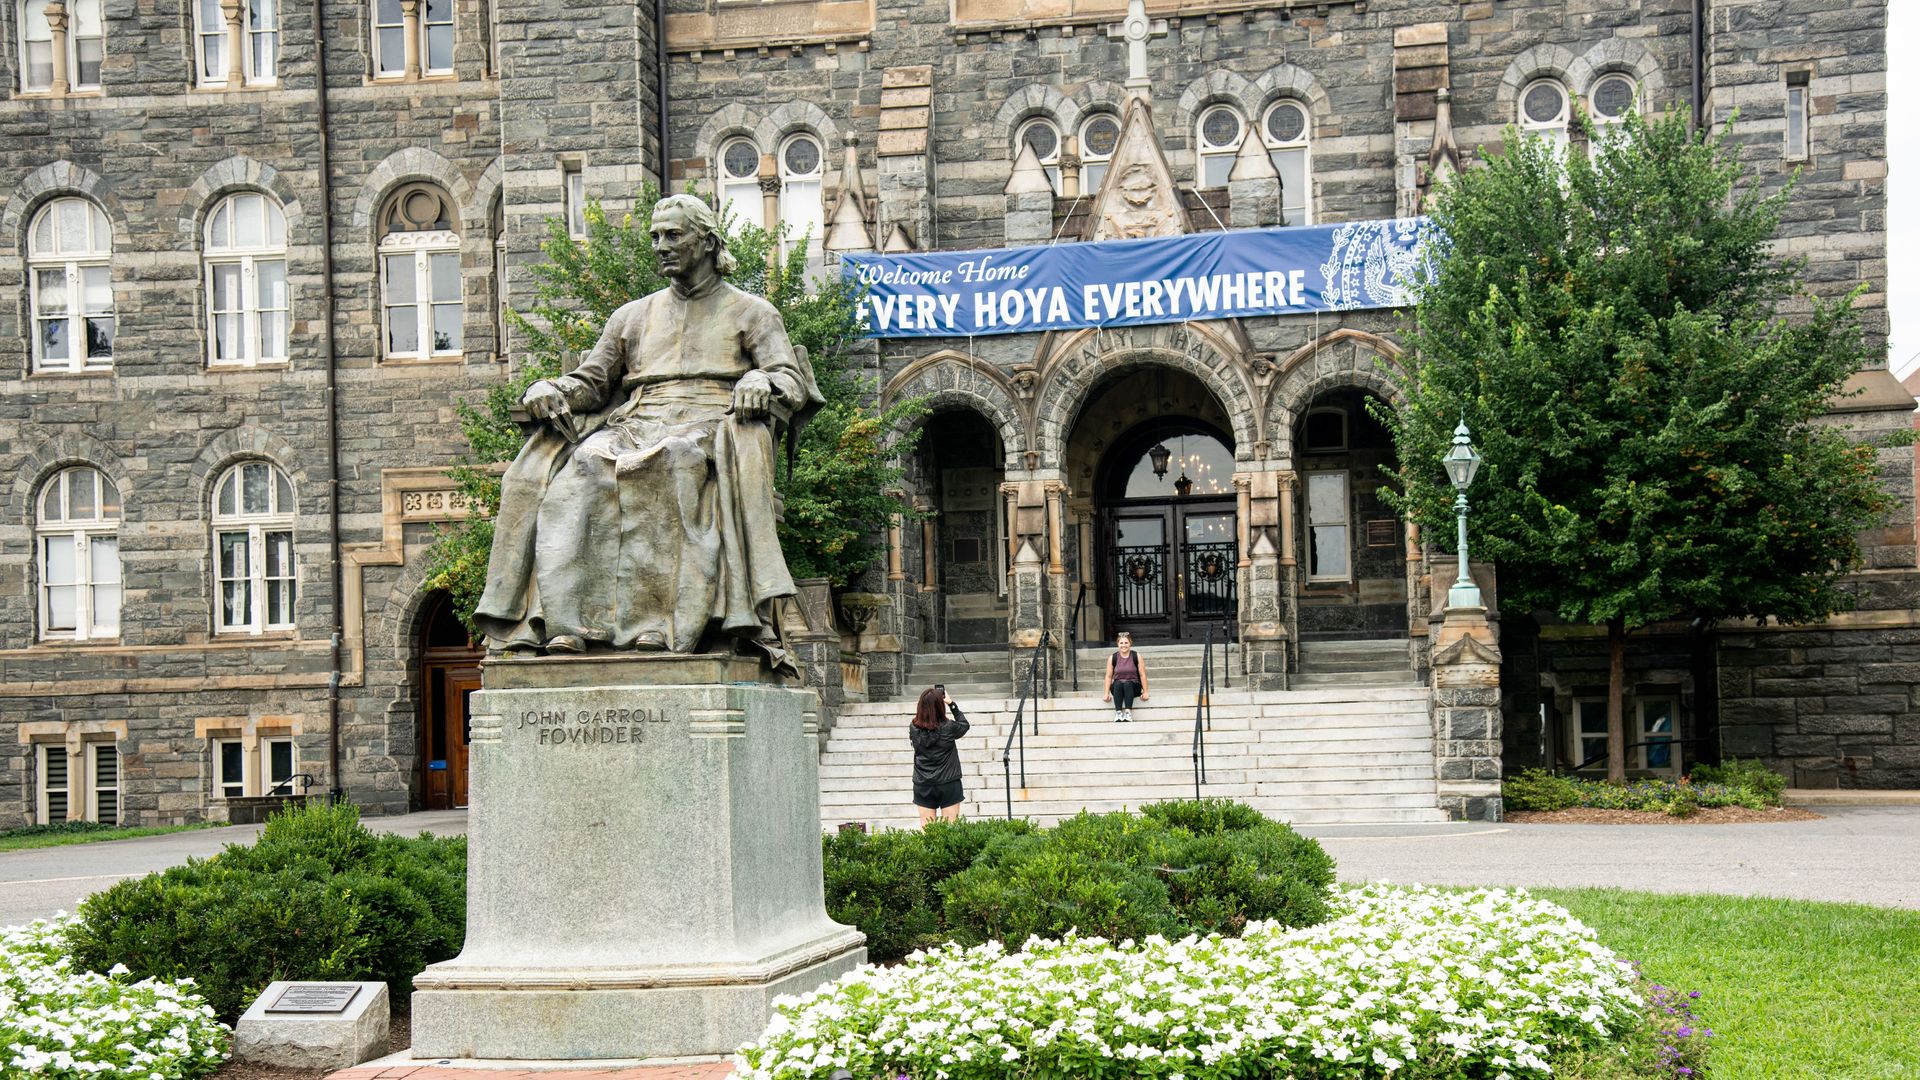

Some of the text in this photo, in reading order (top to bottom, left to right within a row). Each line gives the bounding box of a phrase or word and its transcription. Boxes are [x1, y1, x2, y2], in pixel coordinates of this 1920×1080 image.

[856, 256, 1029, 285] Welcome Home
[855, 270, 1306, 330] EVERY HOYA EVERYWHERE
[1055, 331, 1126, 388] HEALY
[517, 708, 671, 730] JOHN CARROLL
[539, 726, 644, 745] FOVNDER
